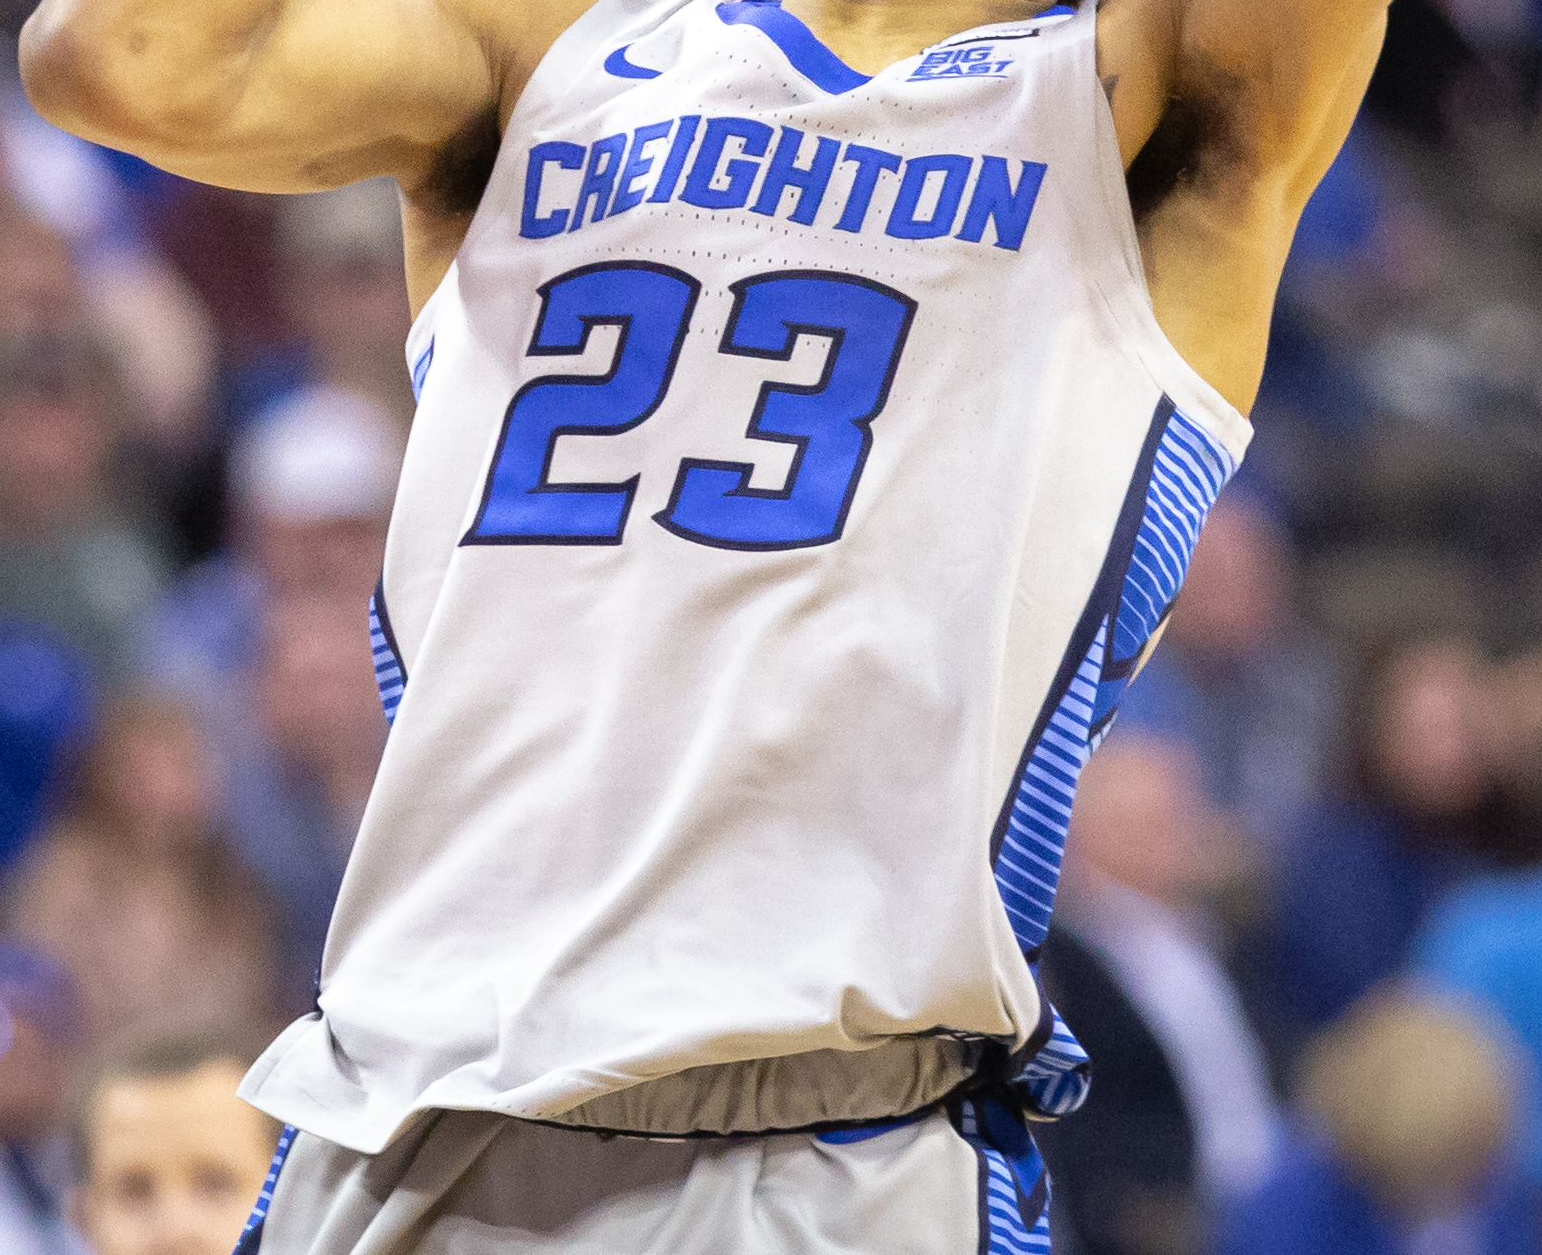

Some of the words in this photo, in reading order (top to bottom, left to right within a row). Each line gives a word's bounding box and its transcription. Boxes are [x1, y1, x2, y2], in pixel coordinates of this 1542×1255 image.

[910, 60, 1015, 77] EAST
[921, 46, 995, 66] BIG
[518, 114, 1048, 252] CREIGHTON
[458, 259, 919, 552] 23
